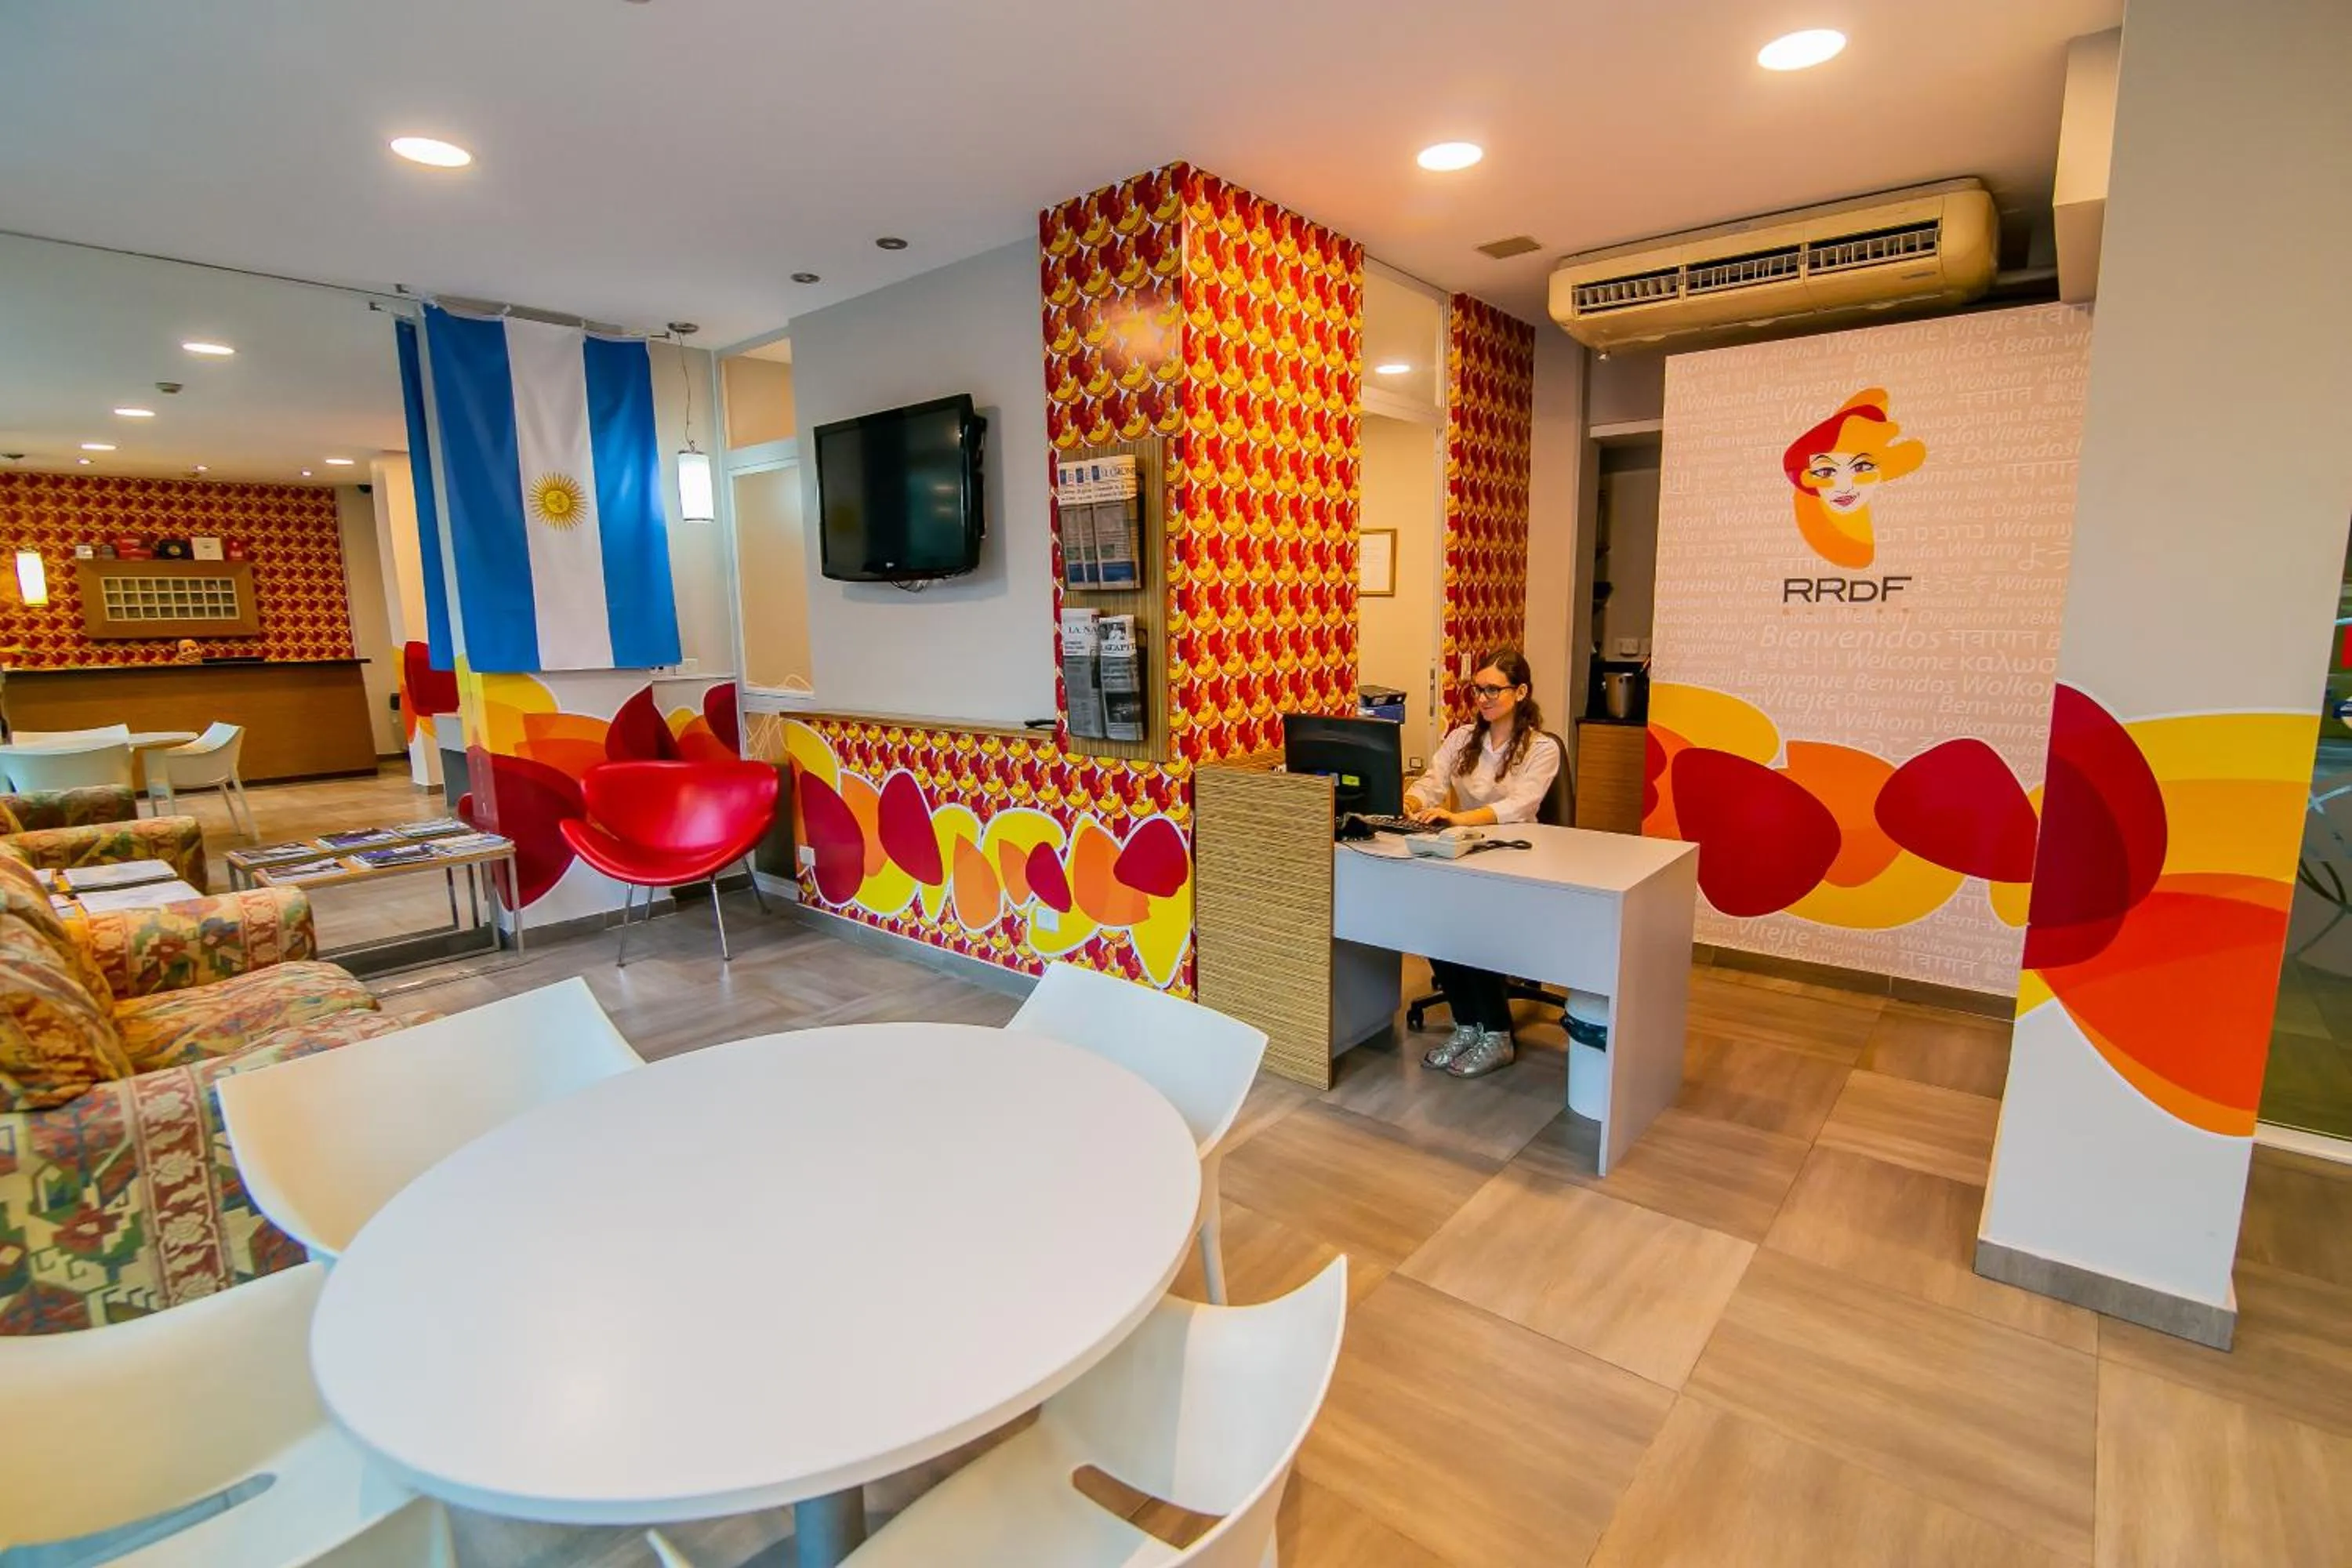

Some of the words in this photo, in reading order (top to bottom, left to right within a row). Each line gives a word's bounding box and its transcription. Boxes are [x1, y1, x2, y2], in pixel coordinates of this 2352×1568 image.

[1825, 320, 1940, 354] Welcome
[1853, 335, 1998, 373] Bienvenidos
[1783, 576, 1913, 603] RRDF
[1759, 615, 1945, 651] Bienvenidos
[1847, 647, 1958, 672] Welcome
[1737, 667, 1847, 692] Bienvenue
[1853, 670, 1958, 695] Benvidos
[1763, 686, 1838, 717] Vitejte
[1835, 709, 1926, 733] Welkom
[1737, 916, 1811, 951] Vitejte
